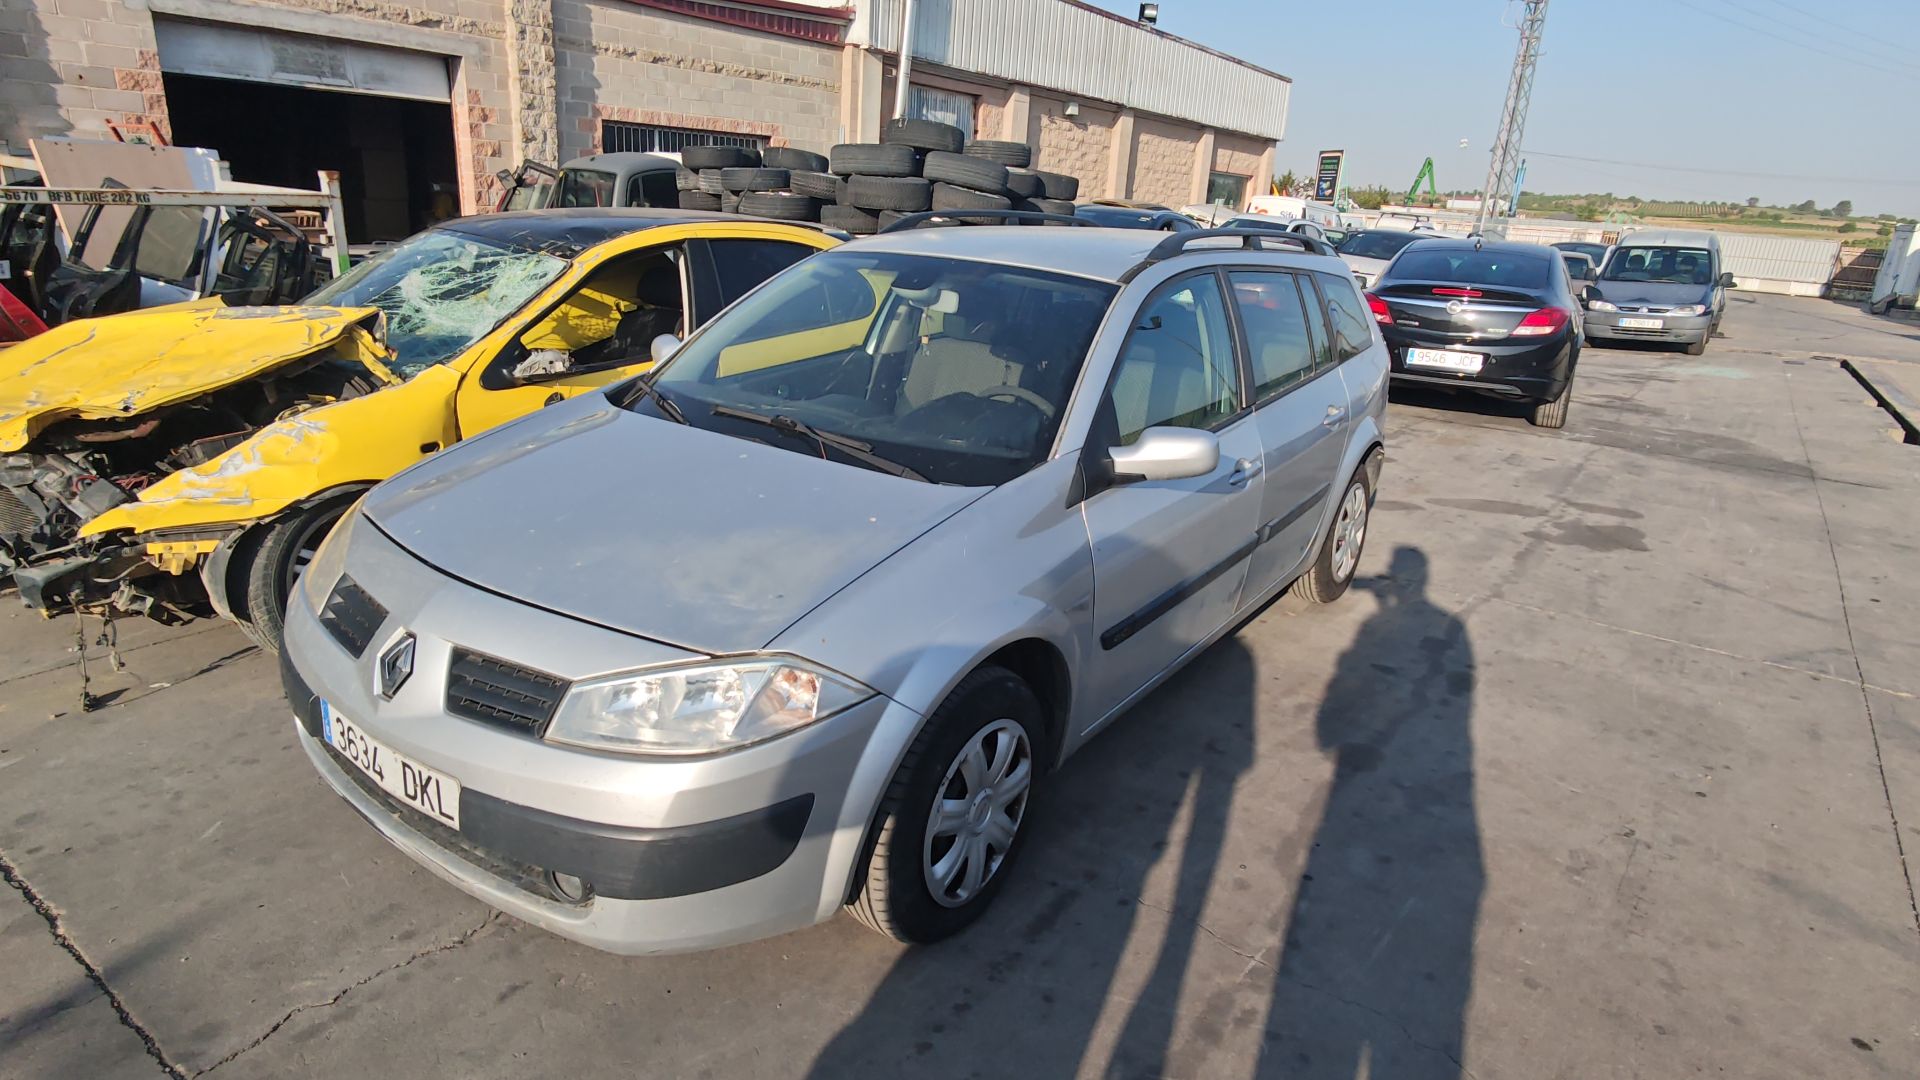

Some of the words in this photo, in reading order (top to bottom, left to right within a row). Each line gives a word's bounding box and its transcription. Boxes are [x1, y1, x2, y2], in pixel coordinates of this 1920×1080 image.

[136, 194, 151, 203] KG
[1417, 351, 1447, 364] 9546
[1454, 355, 1479, 367] JCF
[336, 716, 384, 781] 3634
[401, 760, 455, 821] DKL
